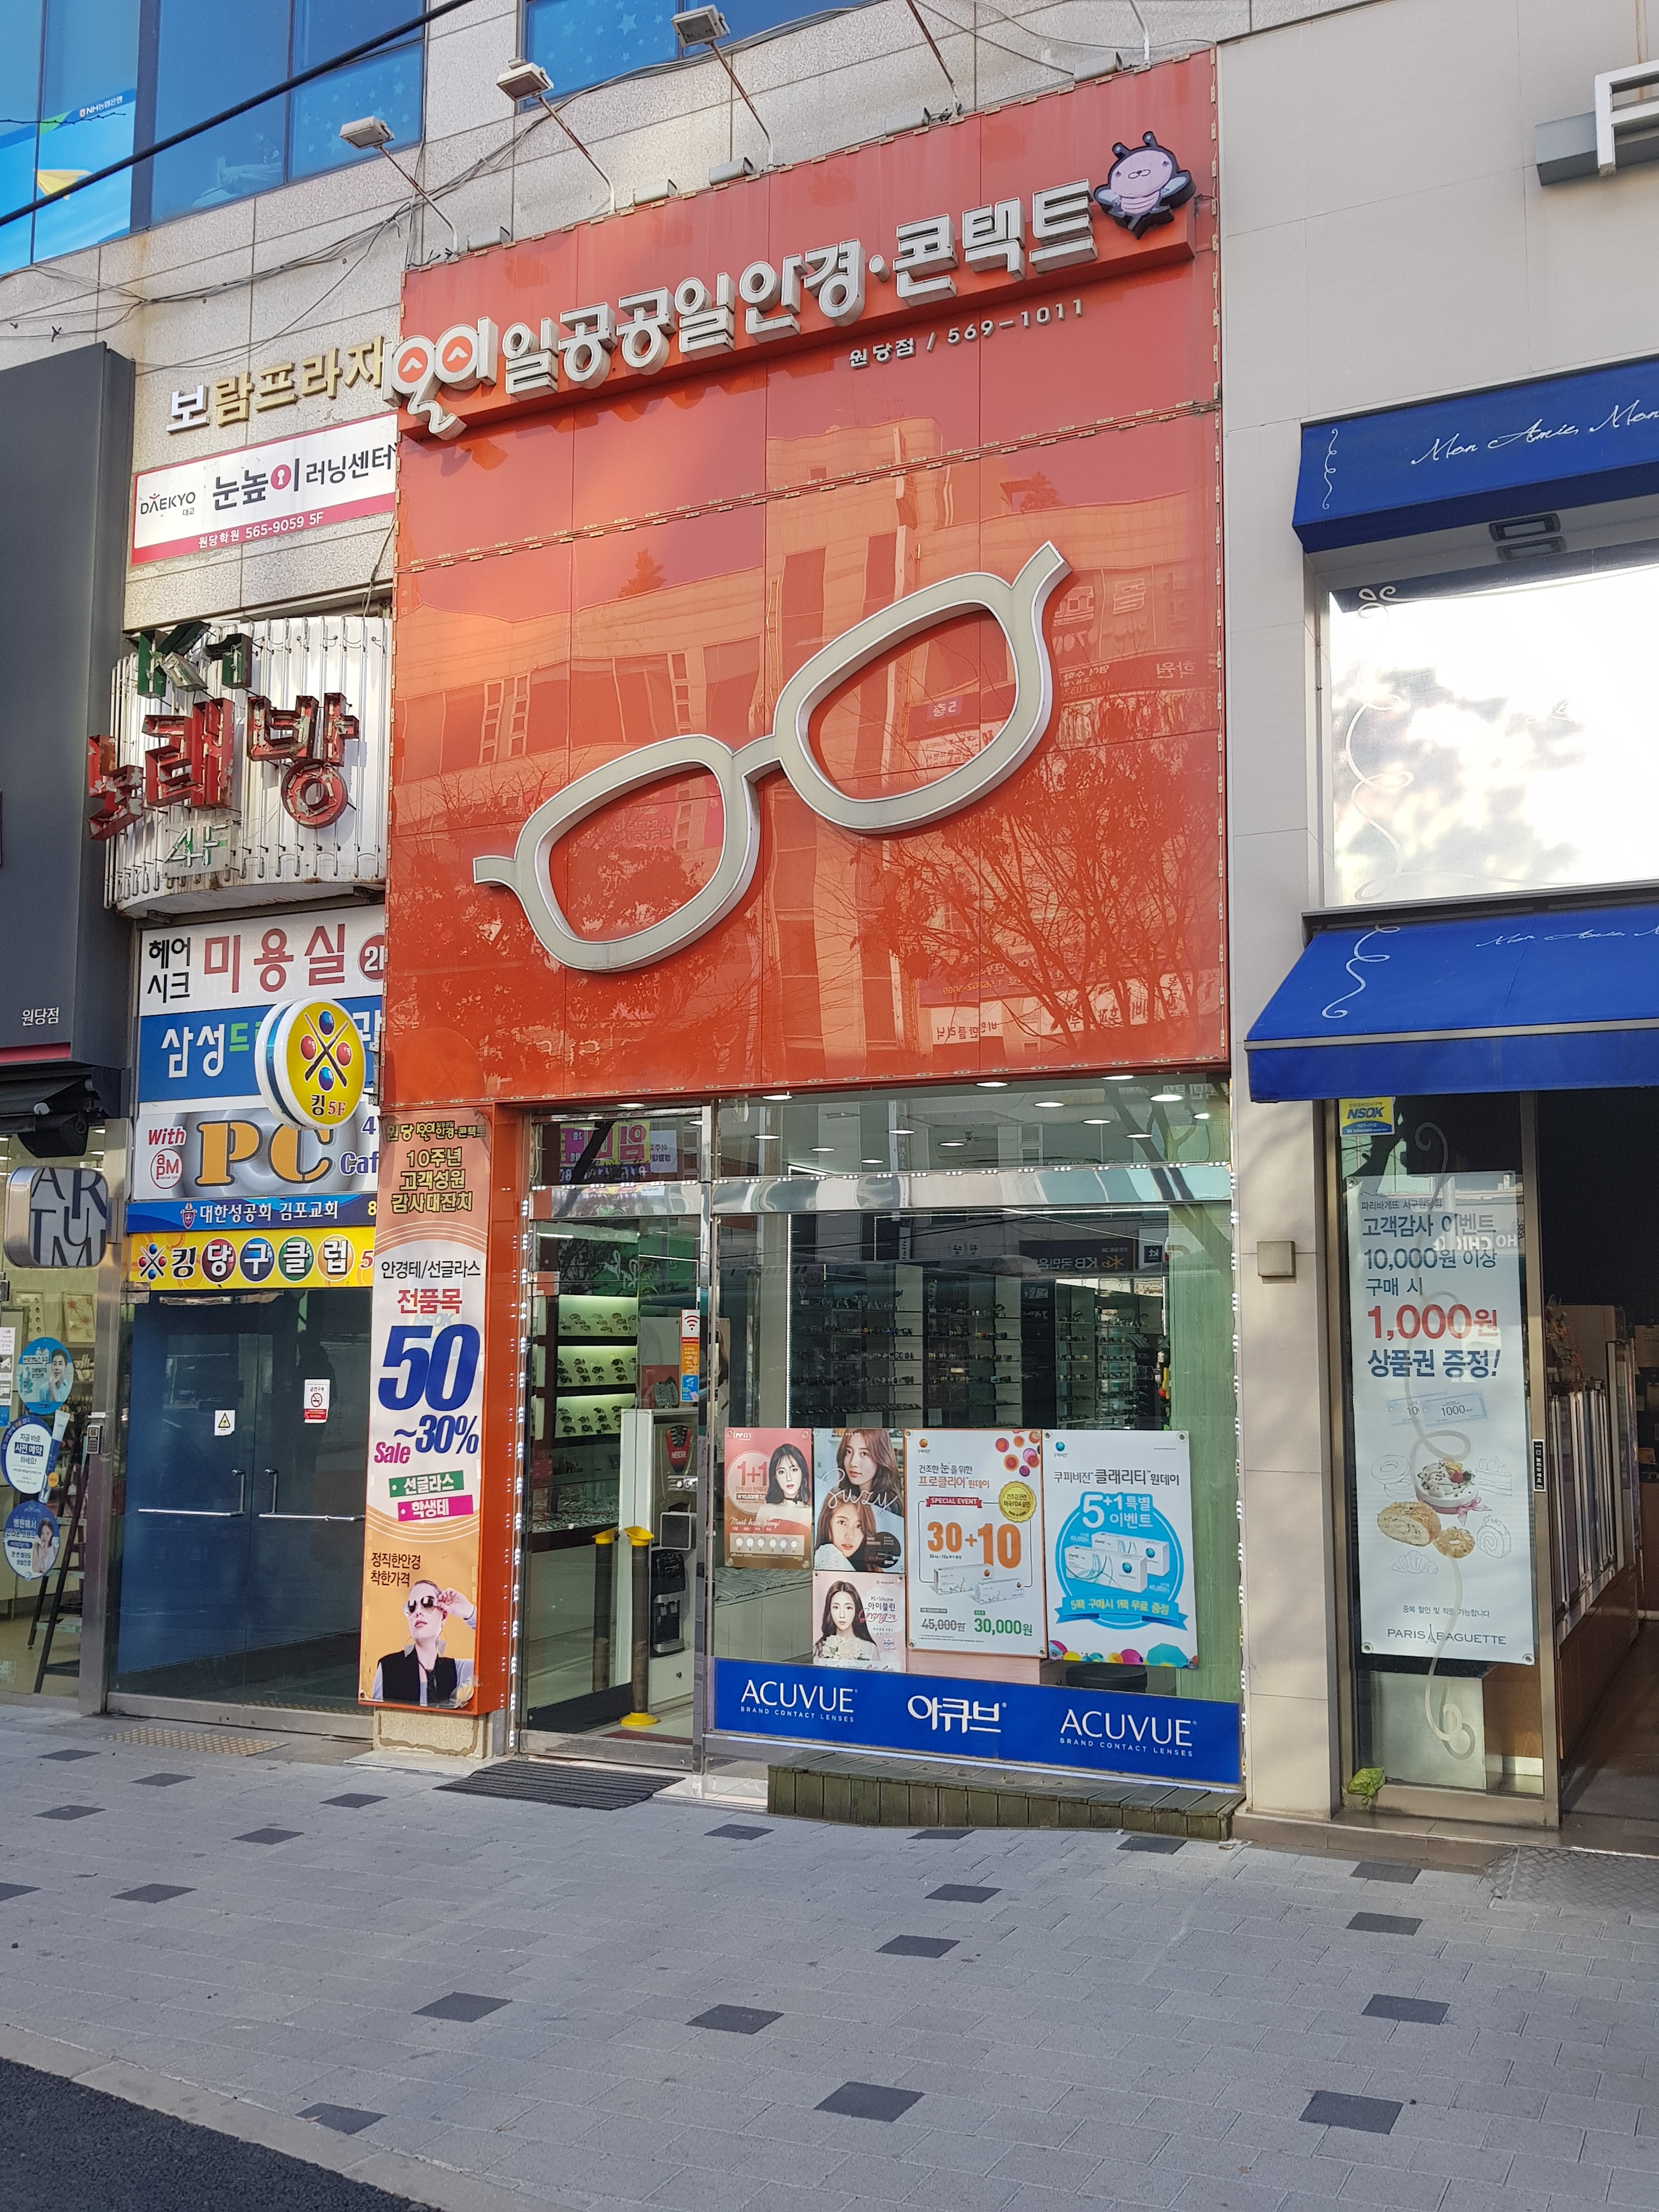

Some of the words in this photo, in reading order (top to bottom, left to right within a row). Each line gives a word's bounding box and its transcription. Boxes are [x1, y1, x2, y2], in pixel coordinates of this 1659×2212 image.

[849, 336, 916, 368] 원당점
[946, 298, 1084, 346] 569-1011
[166, 335, 386, 434] 보람프라자
[306, 447, 393, 486] 러닝센터
[182, 507, 195, 517] 대교
[199, 530, 240, 549] 원당학원
[245, 518, 304, 540] 565-9059
[309, 512, 324, 524] 5F
[165, 820, 228, 867] 4F
[149, 937, 191, 969] 헤어
[204, 923, 346, 994] 미용실
[146, 973, 190, 1003] 시크
[21, 1007, 59, 1026] 원당점
[161, 1022, 261, 1079] 삼성드
[311, 1094, 326, 1116] 킹
[328, 1101, 346, 1116] 5F
[1347, 1107, 1385, 1119] NSOK
[148, 1127, 187, 1146] With
[386, 1122, 414, 1142] 원당
[195, 1120, 334, 1187] PC
[407, 1147, 462, 1168] 10주년
[399, 1169, 466, 1191] 고객성원
[200, 1202, 273, 1224] 대한성공회
[280, 1201, 339, 1221] 김포교회
[391, 1192, 473, 1214] 감사대잔치
[1361, 1201, 1400, 1211] 파리바게뜨
[1362, 1215, 1434, 1238] 고객감사
[1441, 1214, 1497, 1235] 이벤트
[171, 1239, 353, 1279] 킹당구클럽
[381, 1260, 481, 1279] 안경테/선글라스
[1364, 1248, 1457, 1271] 10,000원
[1463, 1249, 1498, 1268] 이상
[1365, 1278, 1398, 1296] 구매
[1406, 1277, 1423, 1296] 시
[398, 1289, 462, 1314] 전품목
[1367, 1305, 1499, 1341] 1,000원
[378, 1324, 480, 1411] 50
[1368, 1349, 1435, 1378] 상품권
[1442, 1349, 1501, 1378] 증정!
[1441, 1404, 1466, 1417] 1000
[394, 1415, 479, 1454] ~30%
[374, 1441, 411, 1464] Sale
[737, 1461, 767, 1486] 1+1
[919, 1465, 939, 1474] 건조한
[940, 1462, 957, 1474] 눈을
[958, 1465, 972, 1474] 위한
[403, 1474, 454, 1495] 선글라스
[968, 1480, 990, 1489] 원데이
[1150, 1474, 1180, 1486] 원데이
[821, 1468, 898, 1516] Suzy
[411, 1500, 450, 1517] 학생테
[1125, 1496, 1150, 1511] 특별
[730, 1516, 747, 1525] Must
[1109, 1513, 1153, 1529] 이벤트
[371, 1552, 421, 1570] 정직한안경
[370, 1570, 410, 1587] 착한가격
[868, 1602, 895, 1612] 아이블린
[1071, 1599, 1085, 1610] 5팩
[1088, 1599, 1114, 1610] 구매시
[1116, 1600, 1129, 1610] 1팩
[1131, 1600, 1148, 1611] 무료
[1152, 1602, 1170, 1615] 증정
[1457, 1609, 1490, 1618] 가능합니다
[921, 1618, 966, 1632] 45,000원
[974, 1618, 1032, 1636] 30,000원
[1387, 1629, 1426, 1640] PARIS
[741, 1679, 854, 1714] ACUVUE
[774, 1709, 816, 1719] CONTACT
[820, 1713, 854, 1723] LENSES
[907, 1695, 1002, 1734] 아큐브
[1060, 1709, 1193, 1746] ACUVUE
[1060, 1737, 1094, 1746] BRAND
[1099, 1741, 1147, 1752] CONTACT
[1153, 1746, 1193, 1757] LENSES
